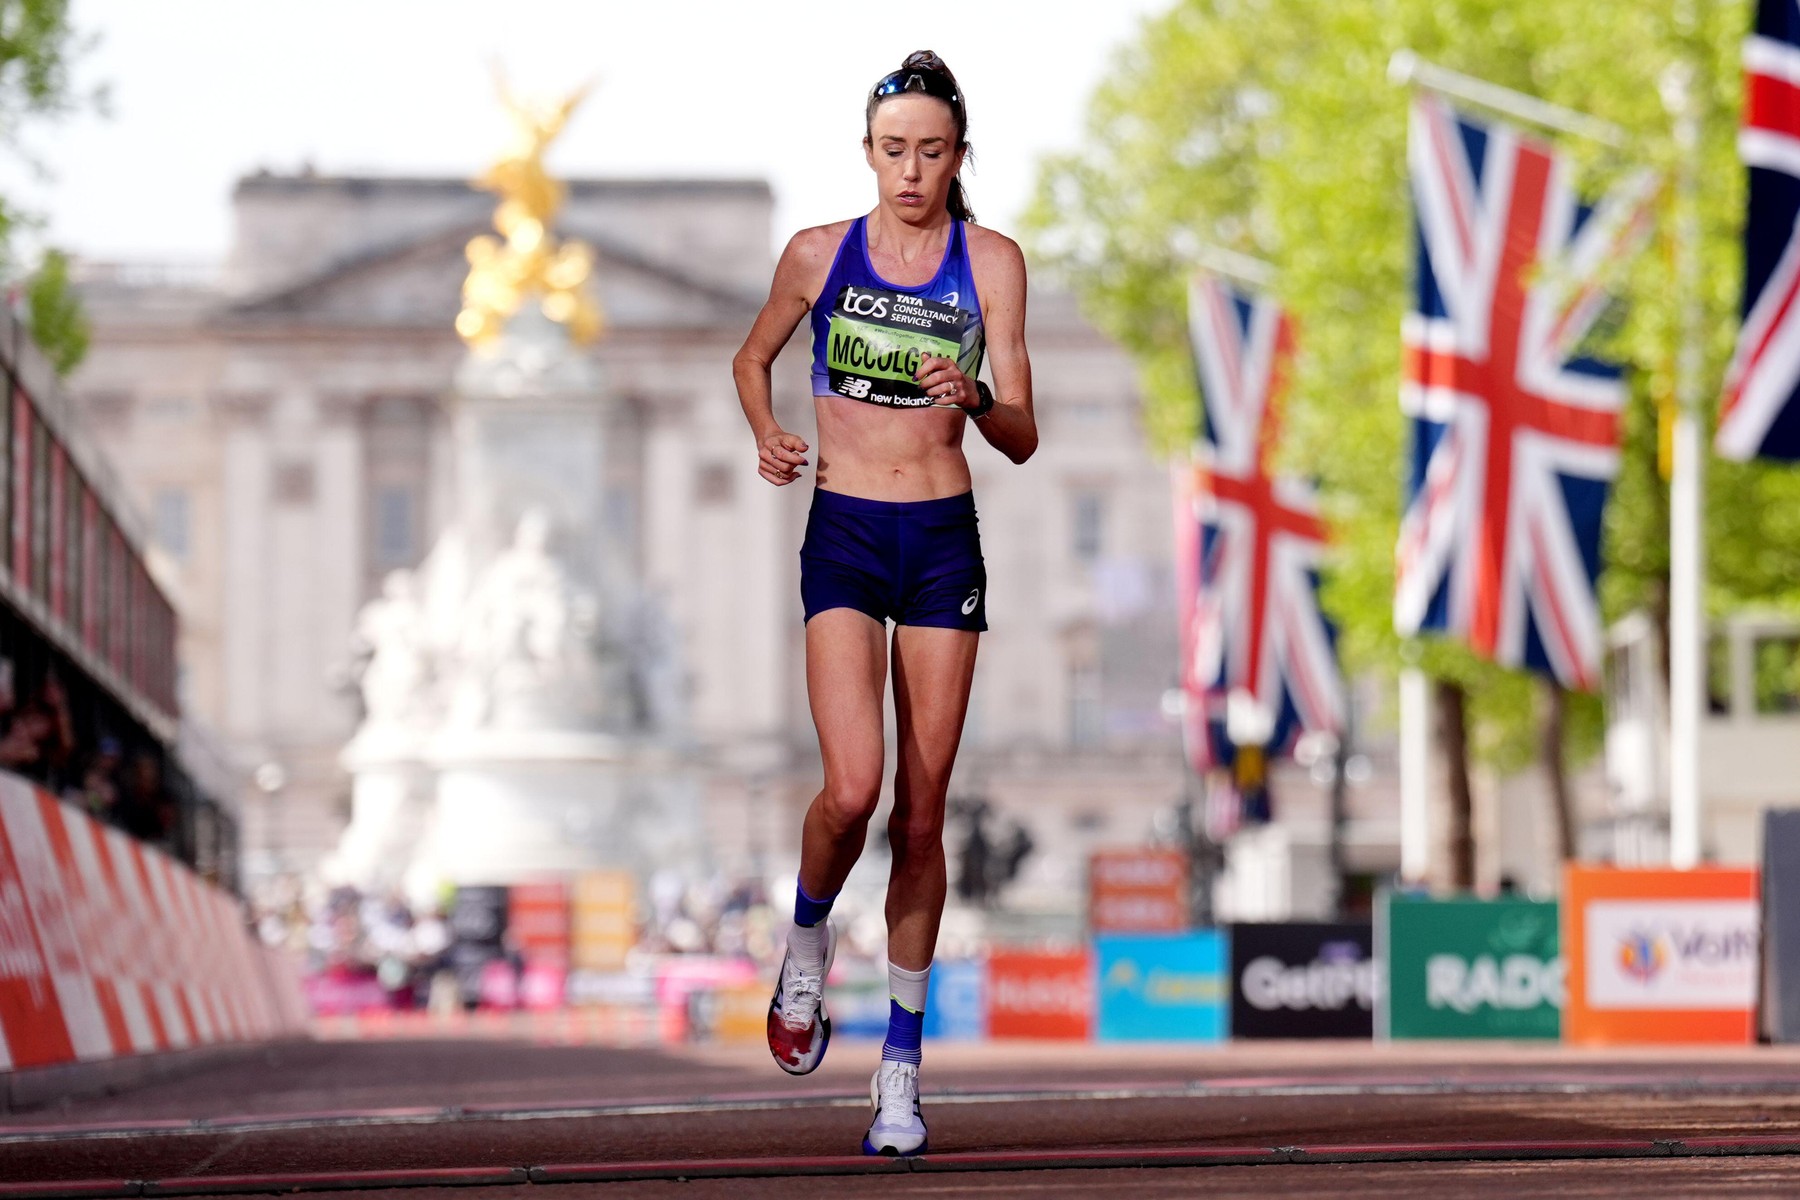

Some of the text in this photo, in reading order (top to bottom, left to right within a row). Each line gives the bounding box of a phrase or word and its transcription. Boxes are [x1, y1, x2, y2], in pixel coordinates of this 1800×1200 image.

[843, 286, 890, 319] tcs
[896, 294, 923, 307] TATA
[890, 313, 932, 328] SERVICES
[893, 304, 959, 325] CONSULTANCY
[832, 333, 950, 377] MCCOLG
[870, 393, 892, 404] new
